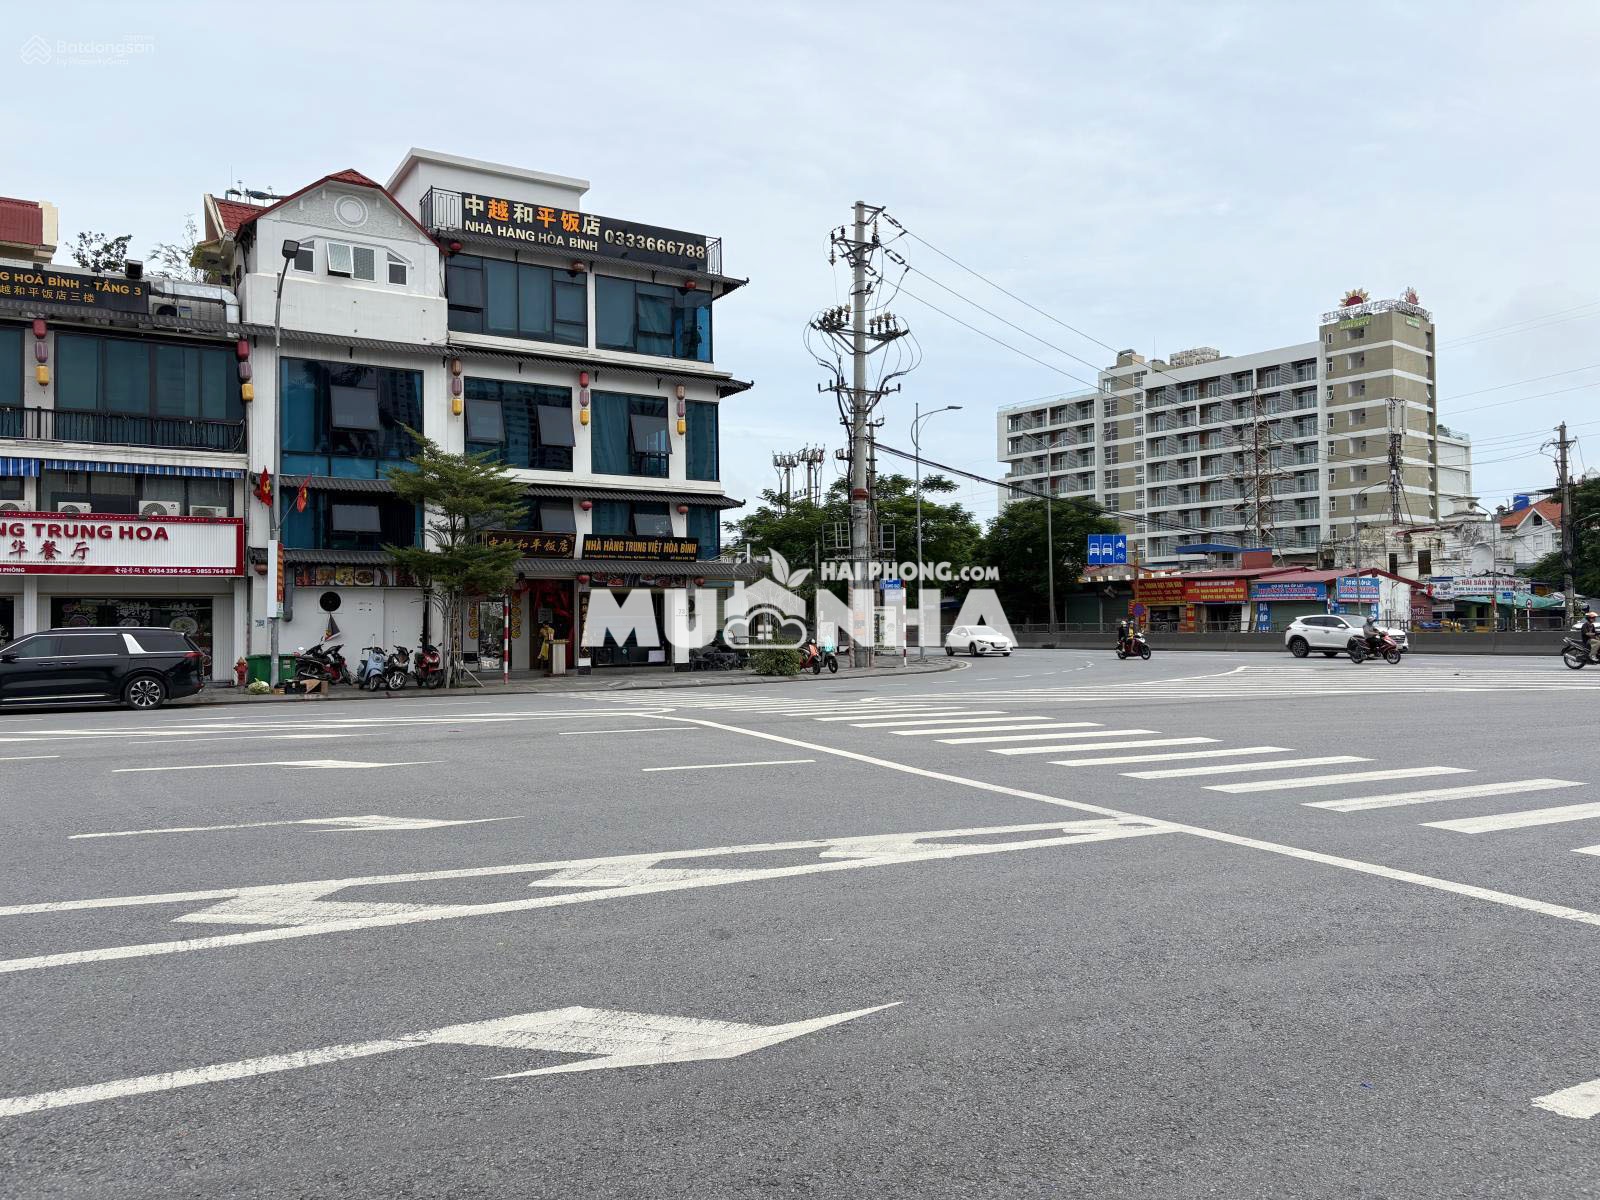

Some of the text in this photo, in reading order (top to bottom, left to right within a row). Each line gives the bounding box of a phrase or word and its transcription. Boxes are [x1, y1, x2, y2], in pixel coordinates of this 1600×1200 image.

[465, 195, 600, 237] 中越和平饭店
[465, 219, 598, 252] NHÀ HÀNG HÒA BÌNH
[604, 229, 705, 260] 0333666788
[14, 273, 44, 285] HOÀ
[48, 275, 79, 289] BÌNH
[94, 279, 130, 294] TẦNG
[134, 287, 142, 296] 3
[32, 523, 113, 539] TRUNG
[119, 525, 169, 541] HOA
[9, 539, 90, 560] 华餐厅
[585, 537, 697, 555] NHÀ HÀNG TRUNG VIỆT HÒA BÌNH
